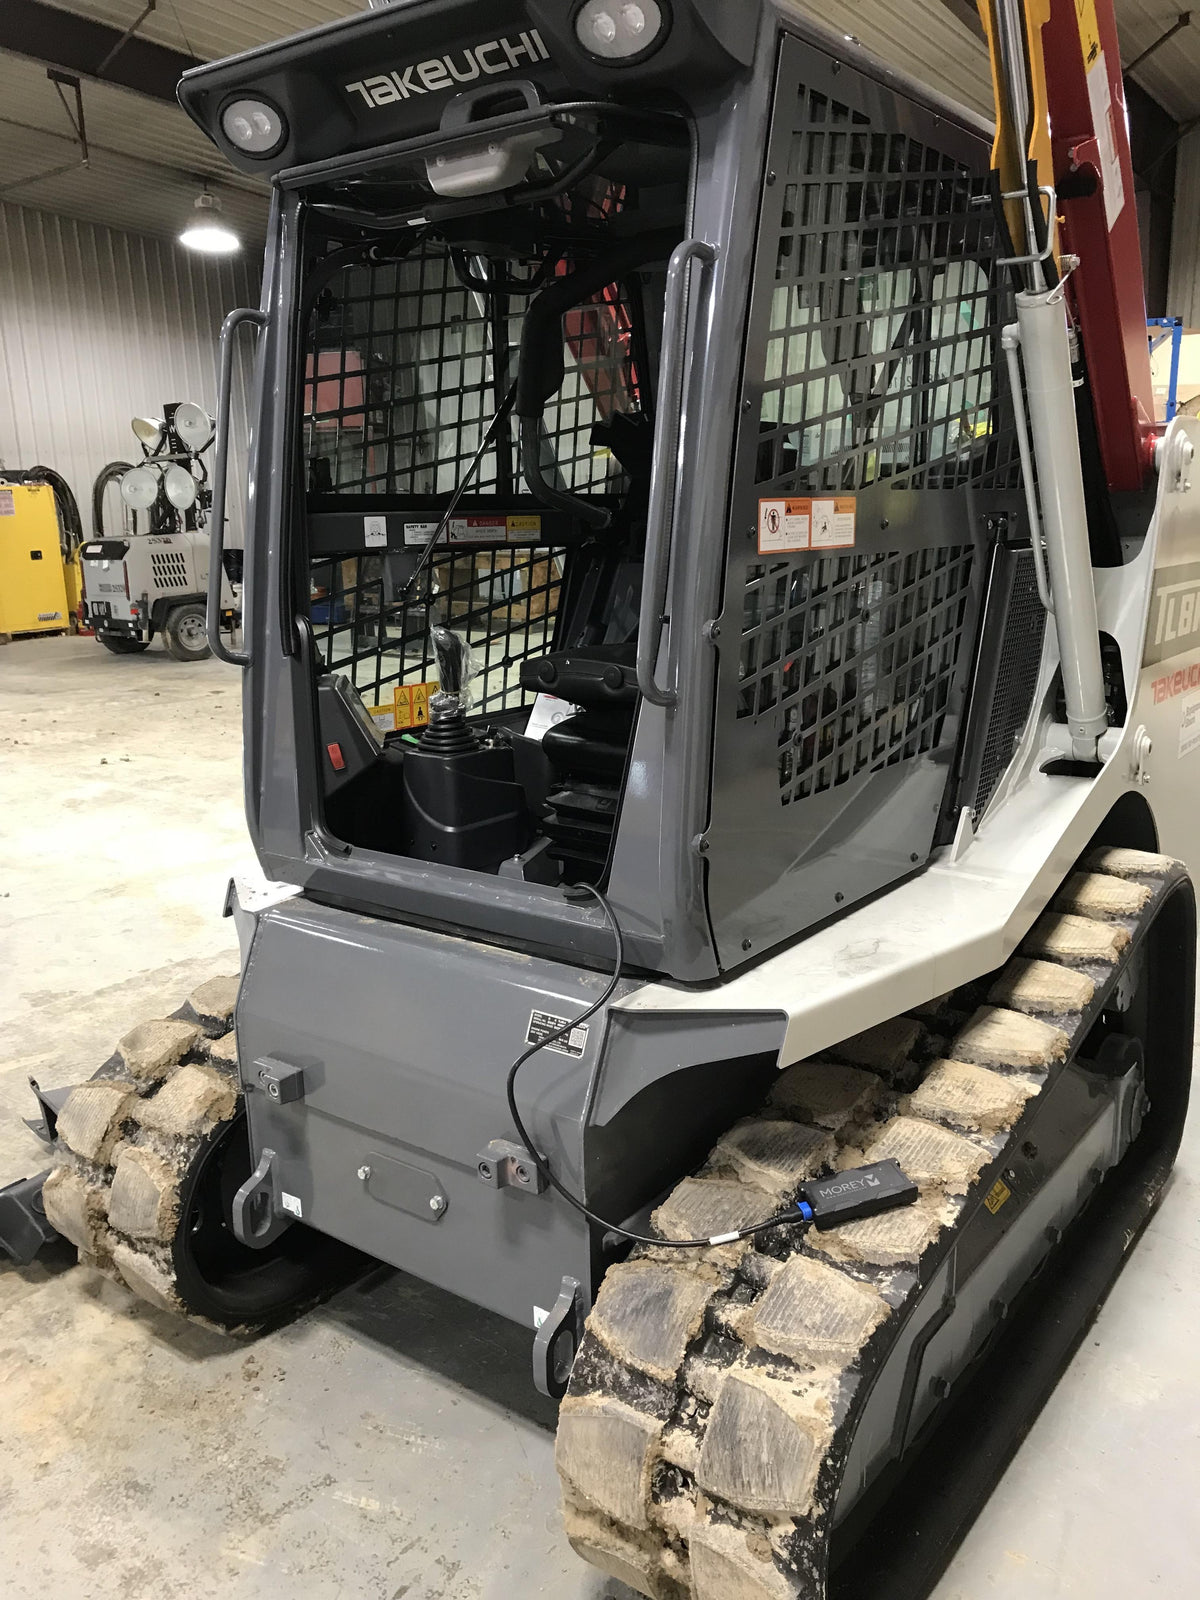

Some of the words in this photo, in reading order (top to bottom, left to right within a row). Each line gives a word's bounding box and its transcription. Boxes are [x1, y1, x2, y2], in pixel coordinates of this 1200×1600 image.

[345, 29, 551, 109] TAKEUCHI
[1151, 663, 1200, 706] TAKEUC
[819, 1178, 865, 1198] MOREY
